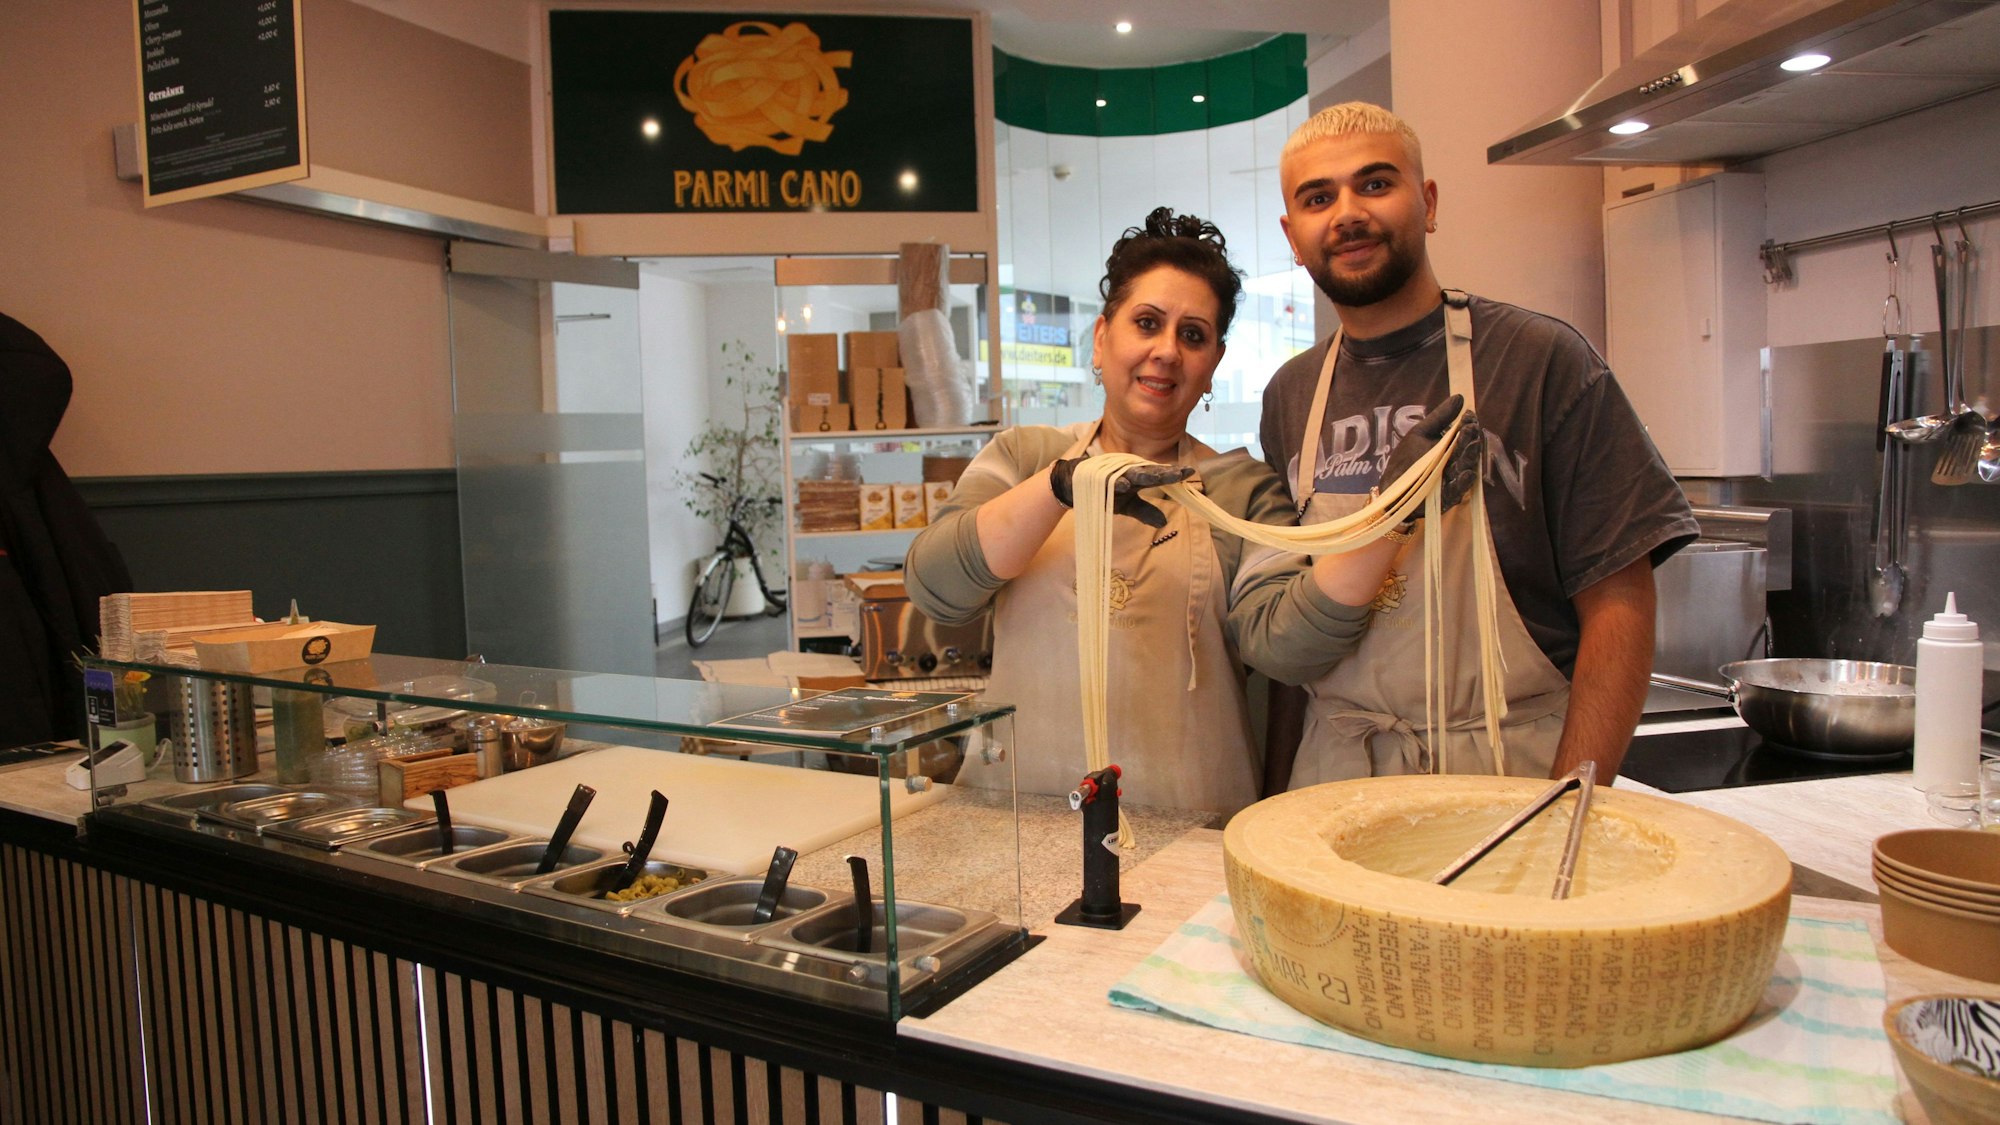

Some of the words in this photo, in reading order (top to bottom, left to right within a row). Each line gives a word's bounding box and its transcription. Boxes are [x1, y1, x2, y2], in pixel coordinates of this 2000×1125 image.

[673, 169, 770, 207] PARMI
[780, 169, 862, 207] CANO
[1016, 321, 1069, 345] EITERS
[1318, 452, 1374, 480] Palm
[1378, 917, 1406, 1020] REGGIANO
[1409, 923, 1436, 1042] PARMIGIANO
[1317, 972, 1351, 1006] 23
